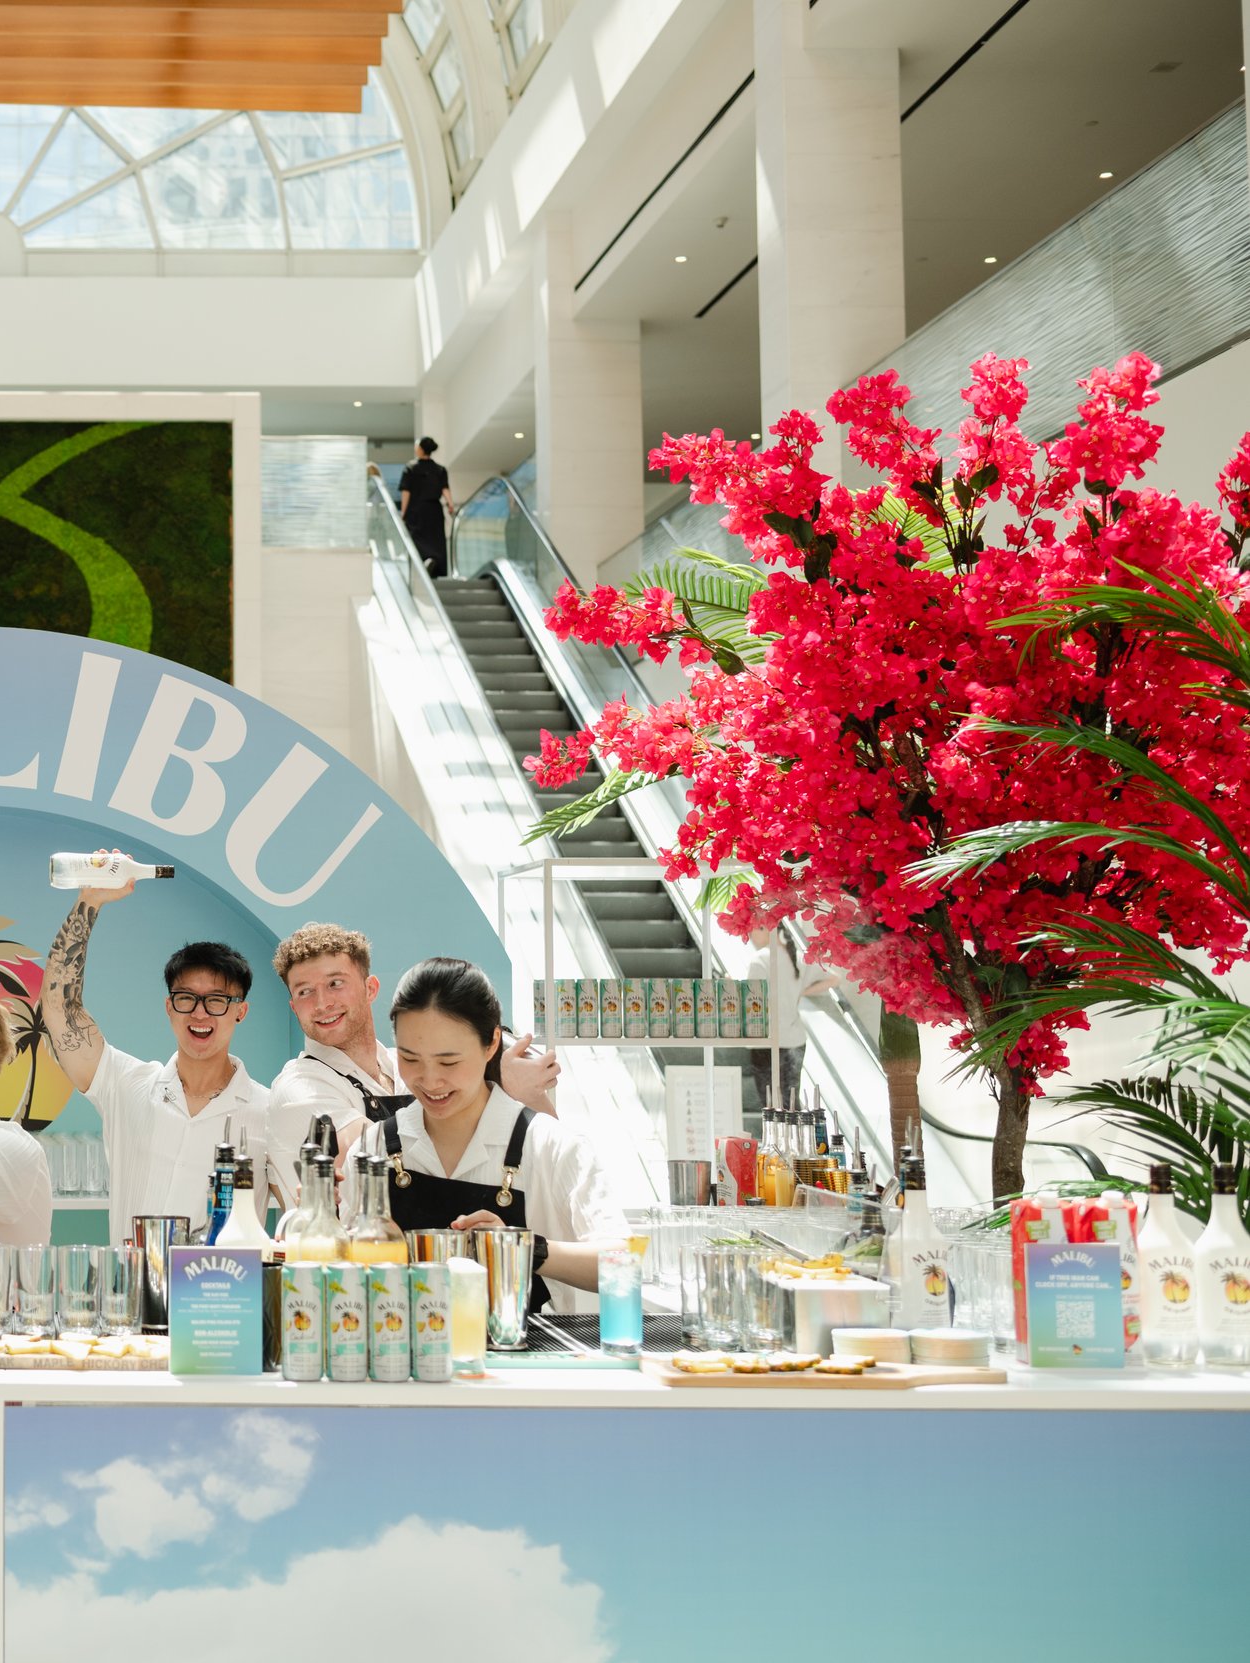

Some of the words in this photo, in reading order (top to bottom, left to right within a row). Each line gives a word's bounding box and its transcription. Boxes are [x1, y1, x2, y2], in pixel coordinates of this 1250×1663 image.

[1050, 1250, 1096, 1268] MALIBU
[184, 1256, 248, 1281] MALIBU
[82, 1358, 137, 1370] HICKORY
[139, 1358, 169, 1370] CHE
